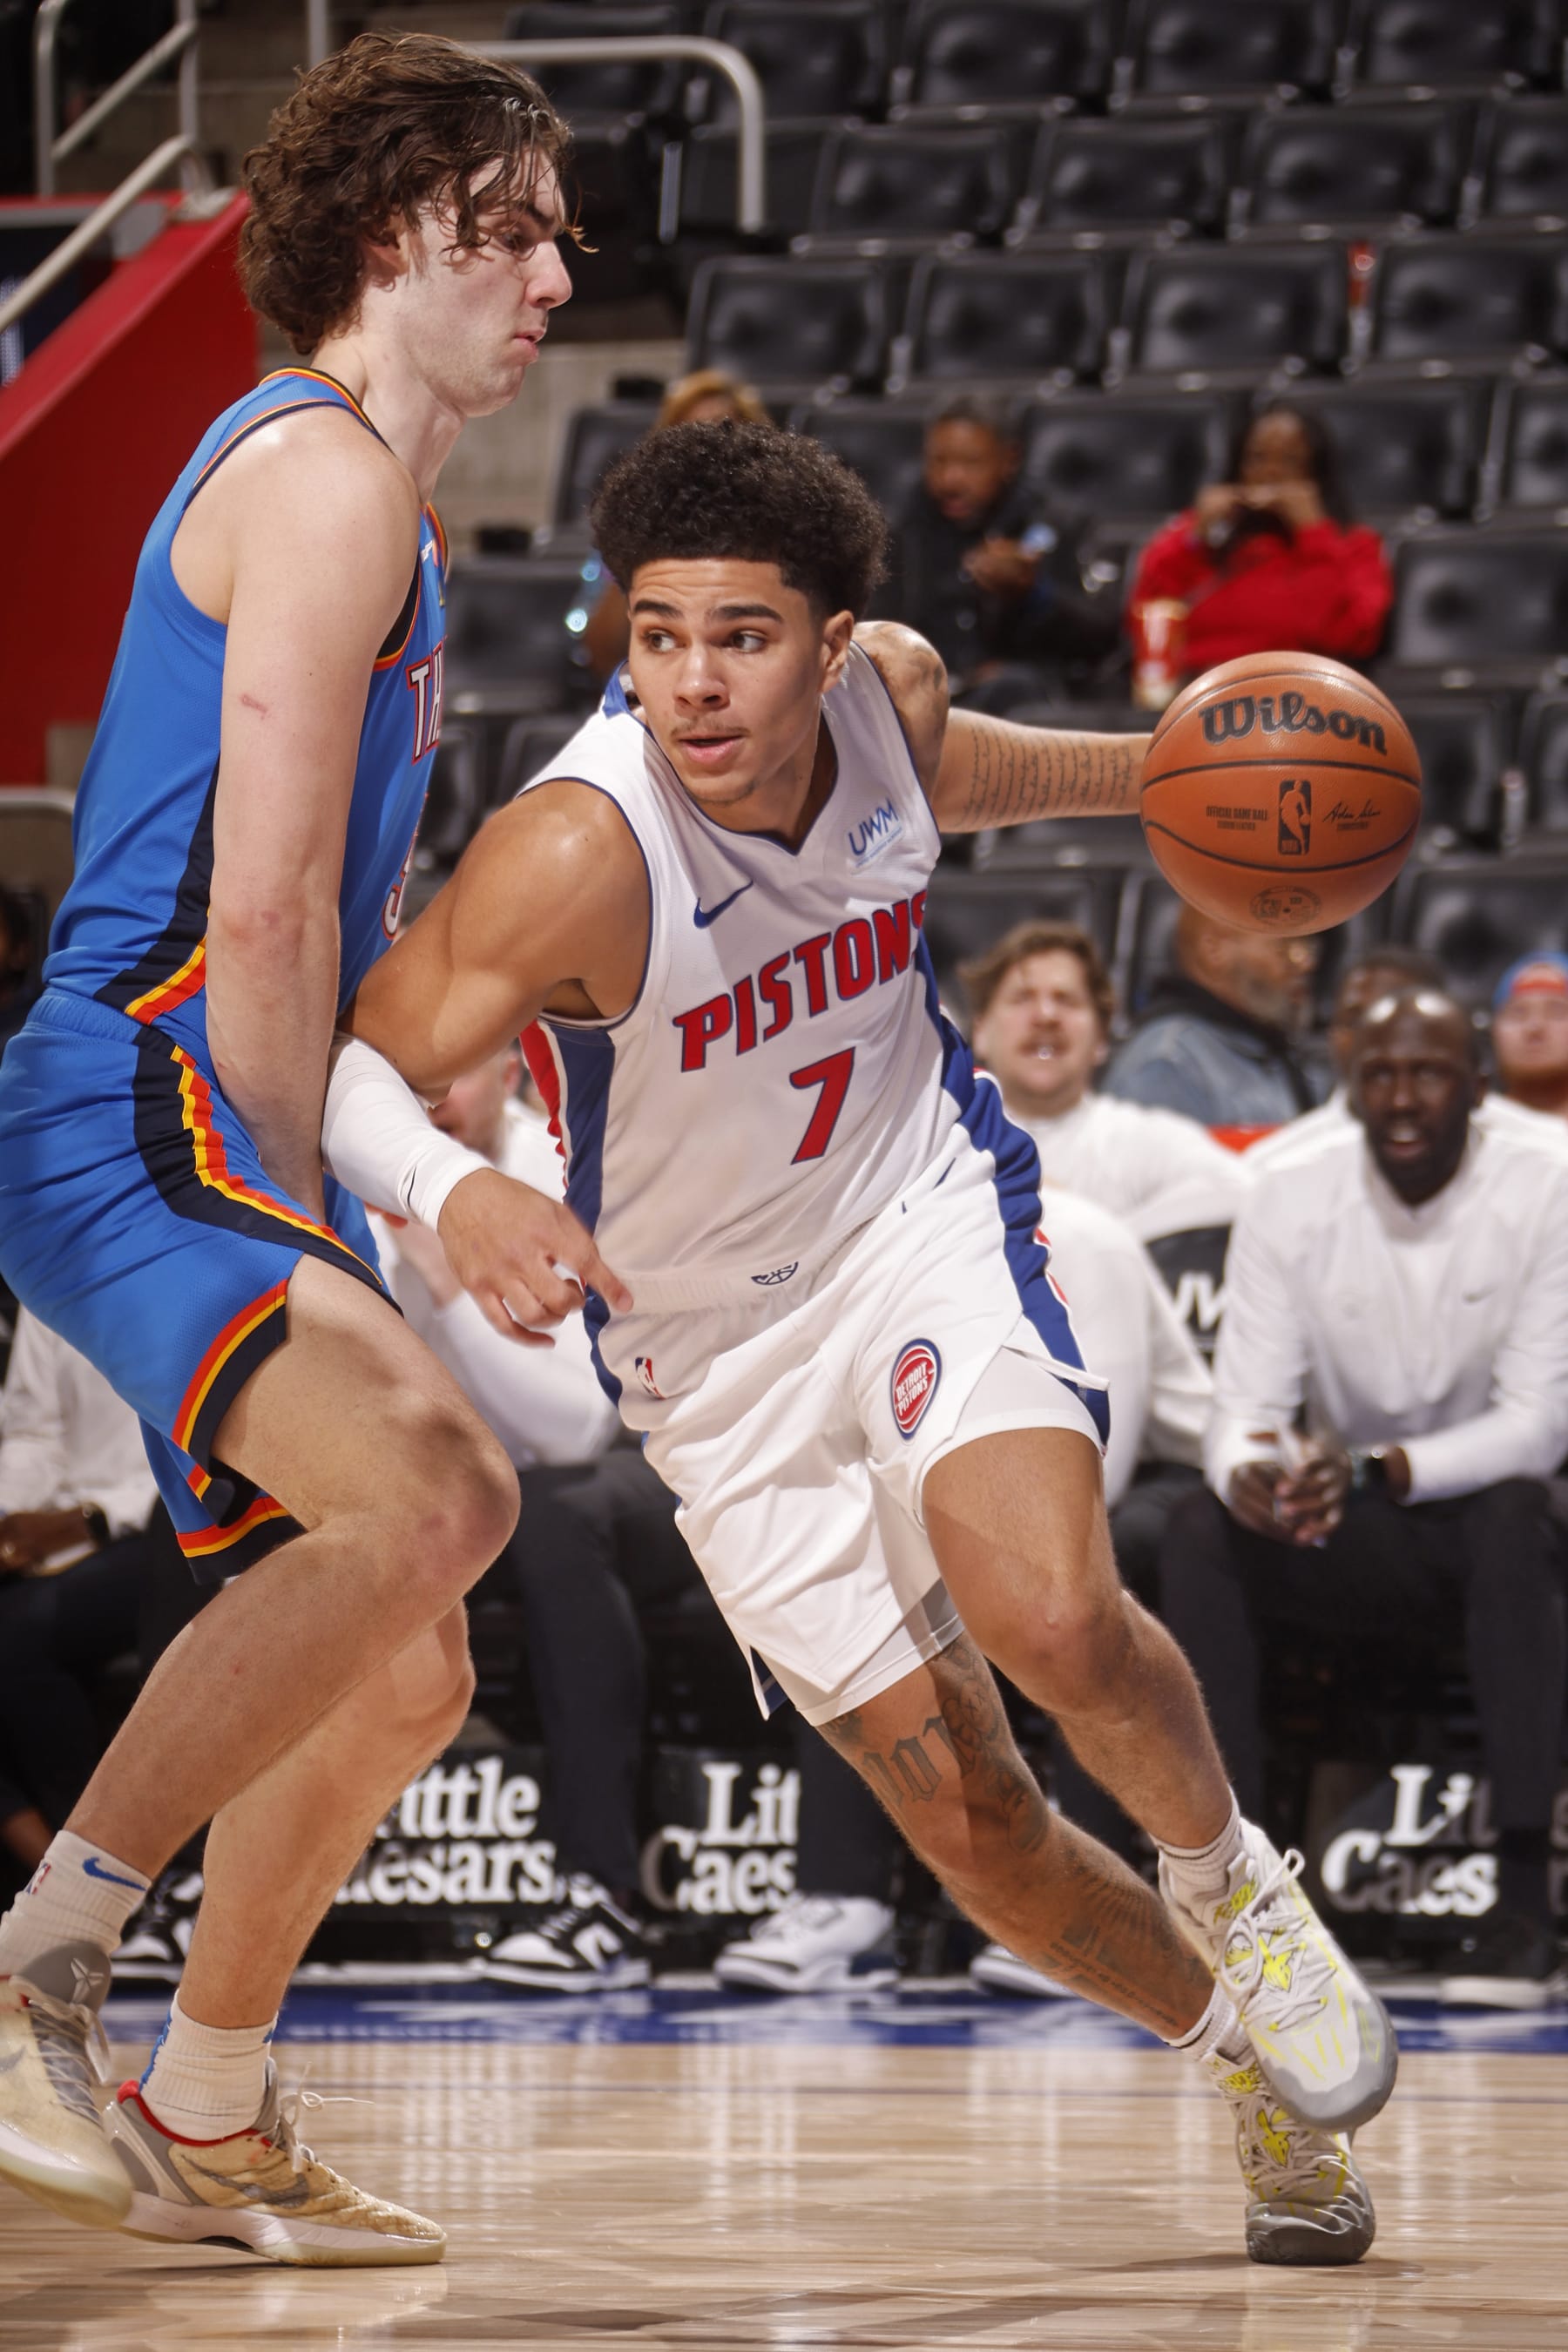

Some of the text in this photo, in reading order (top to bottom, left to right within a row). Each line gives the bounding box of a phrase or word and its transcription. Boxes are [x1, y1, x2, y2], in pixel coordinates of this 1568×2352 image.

[1199, 691, 1387, 756] Wilson
[848, 796, 899, 855] UWM
[789, 1045, 856, 1166] 7
[896, 1362, 928, 1402] DETROIT
[897, 1376, 929, 1416] PISTONS
[375, 1754, 540, 1840] ittle
[334, 1839, 557, 1905] esars
[1321, 1828, 1500, 1916] Caes
